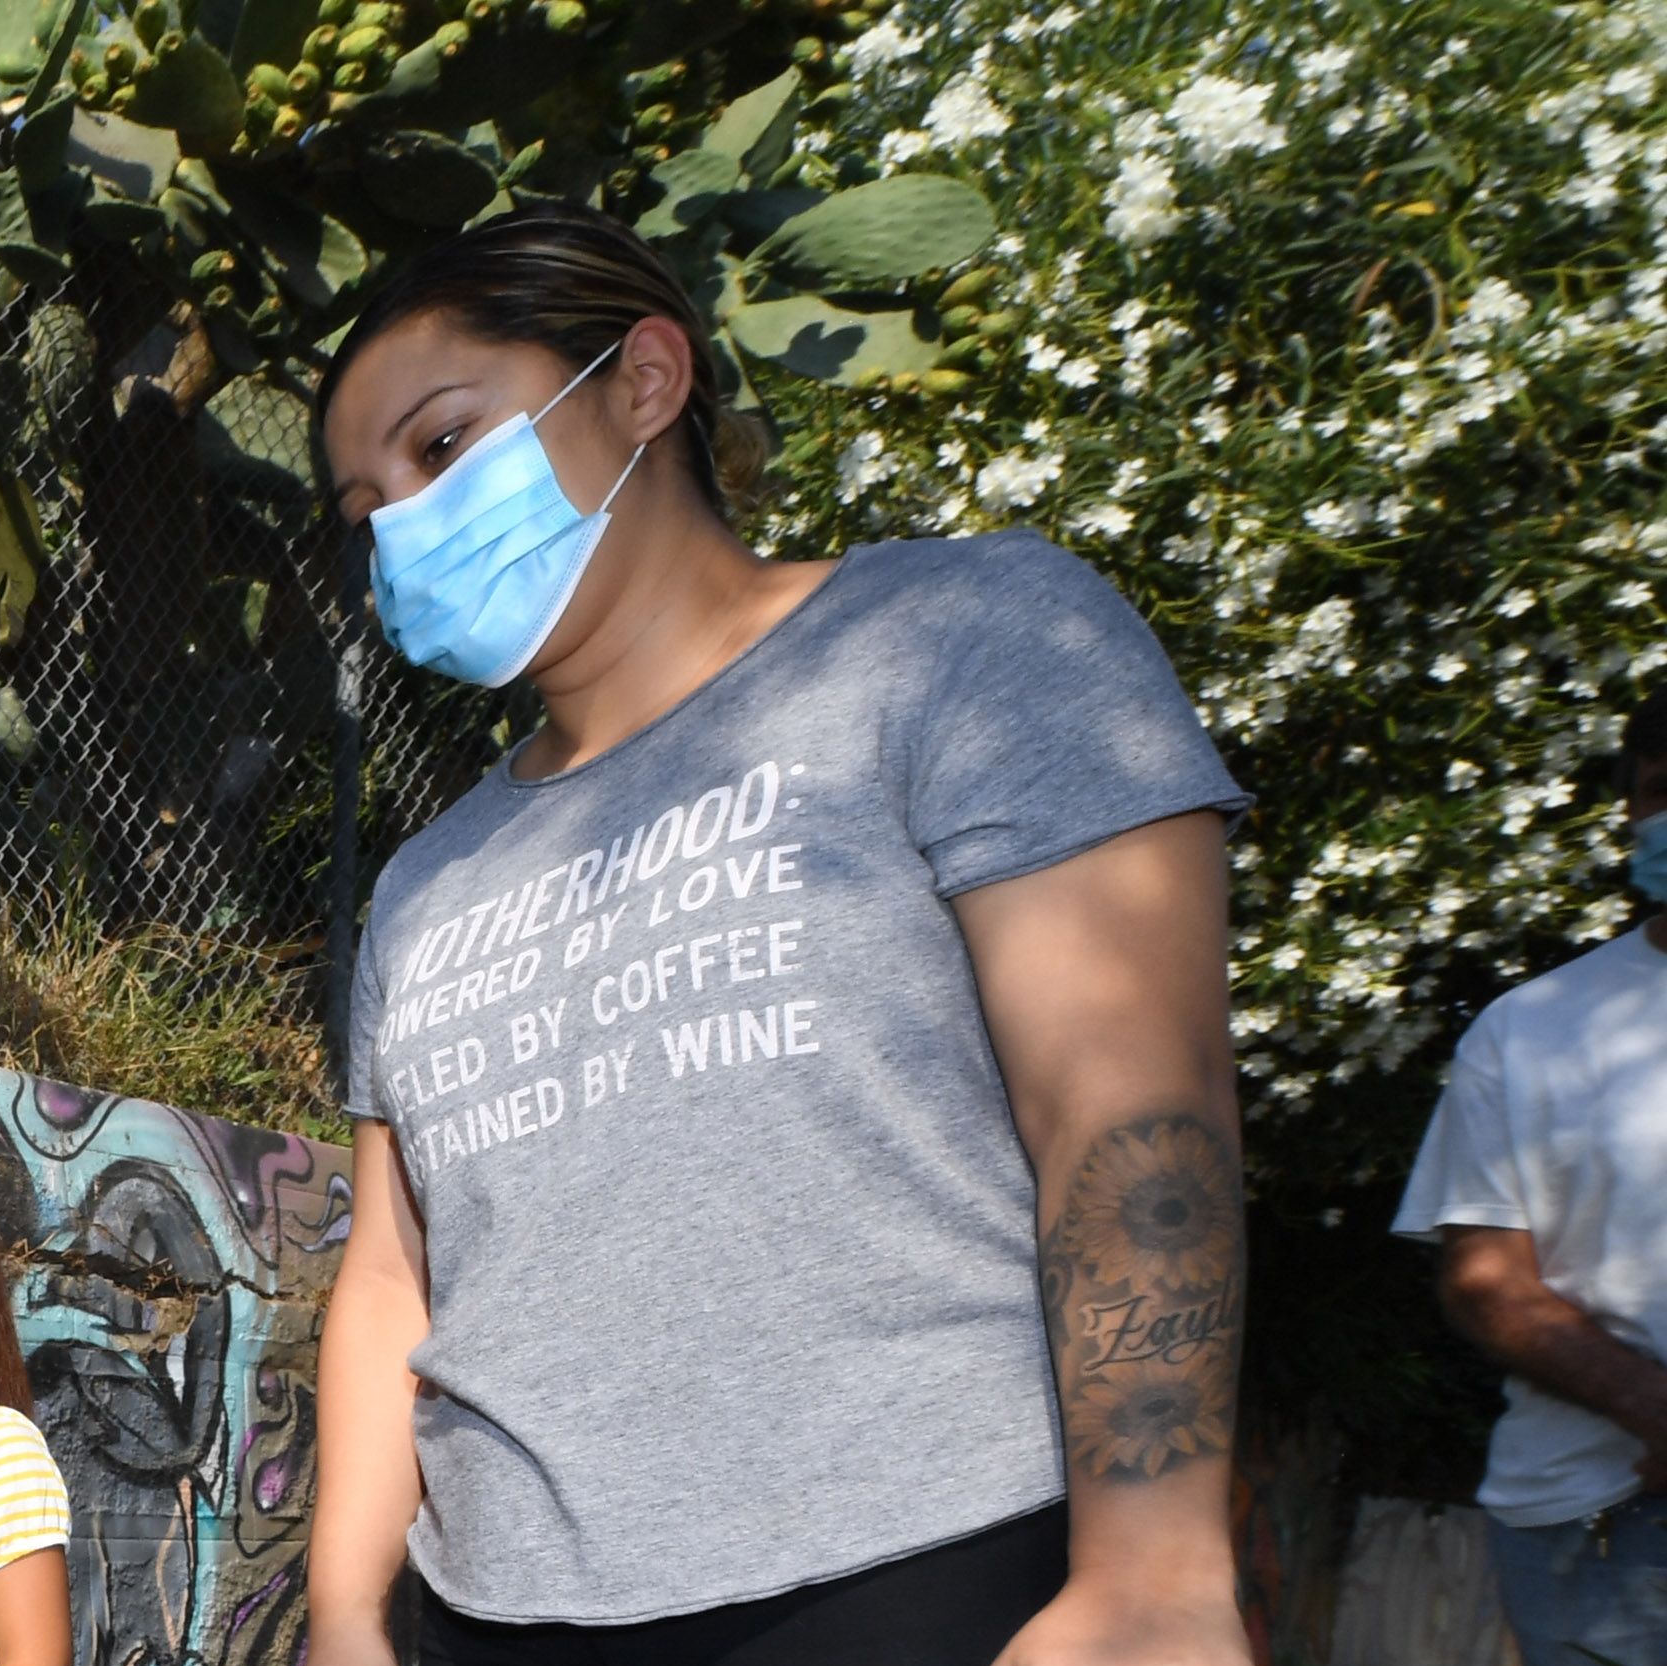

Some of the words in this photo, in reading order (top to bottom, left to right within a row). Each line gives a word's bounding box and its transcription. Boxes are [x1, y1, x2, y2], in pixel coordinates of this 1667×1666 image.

[375, 946, 541, 1056] OWERED
[564, 902, 628, 969] BY
[649, 843, 803, 928] LOVE
[510, 998, 567, 1065] BY
[592, 920, 804, 1026] COFFEE
[583, 1039, 636, 1108] BY
[662, 1000, 820, 1078] WINE
